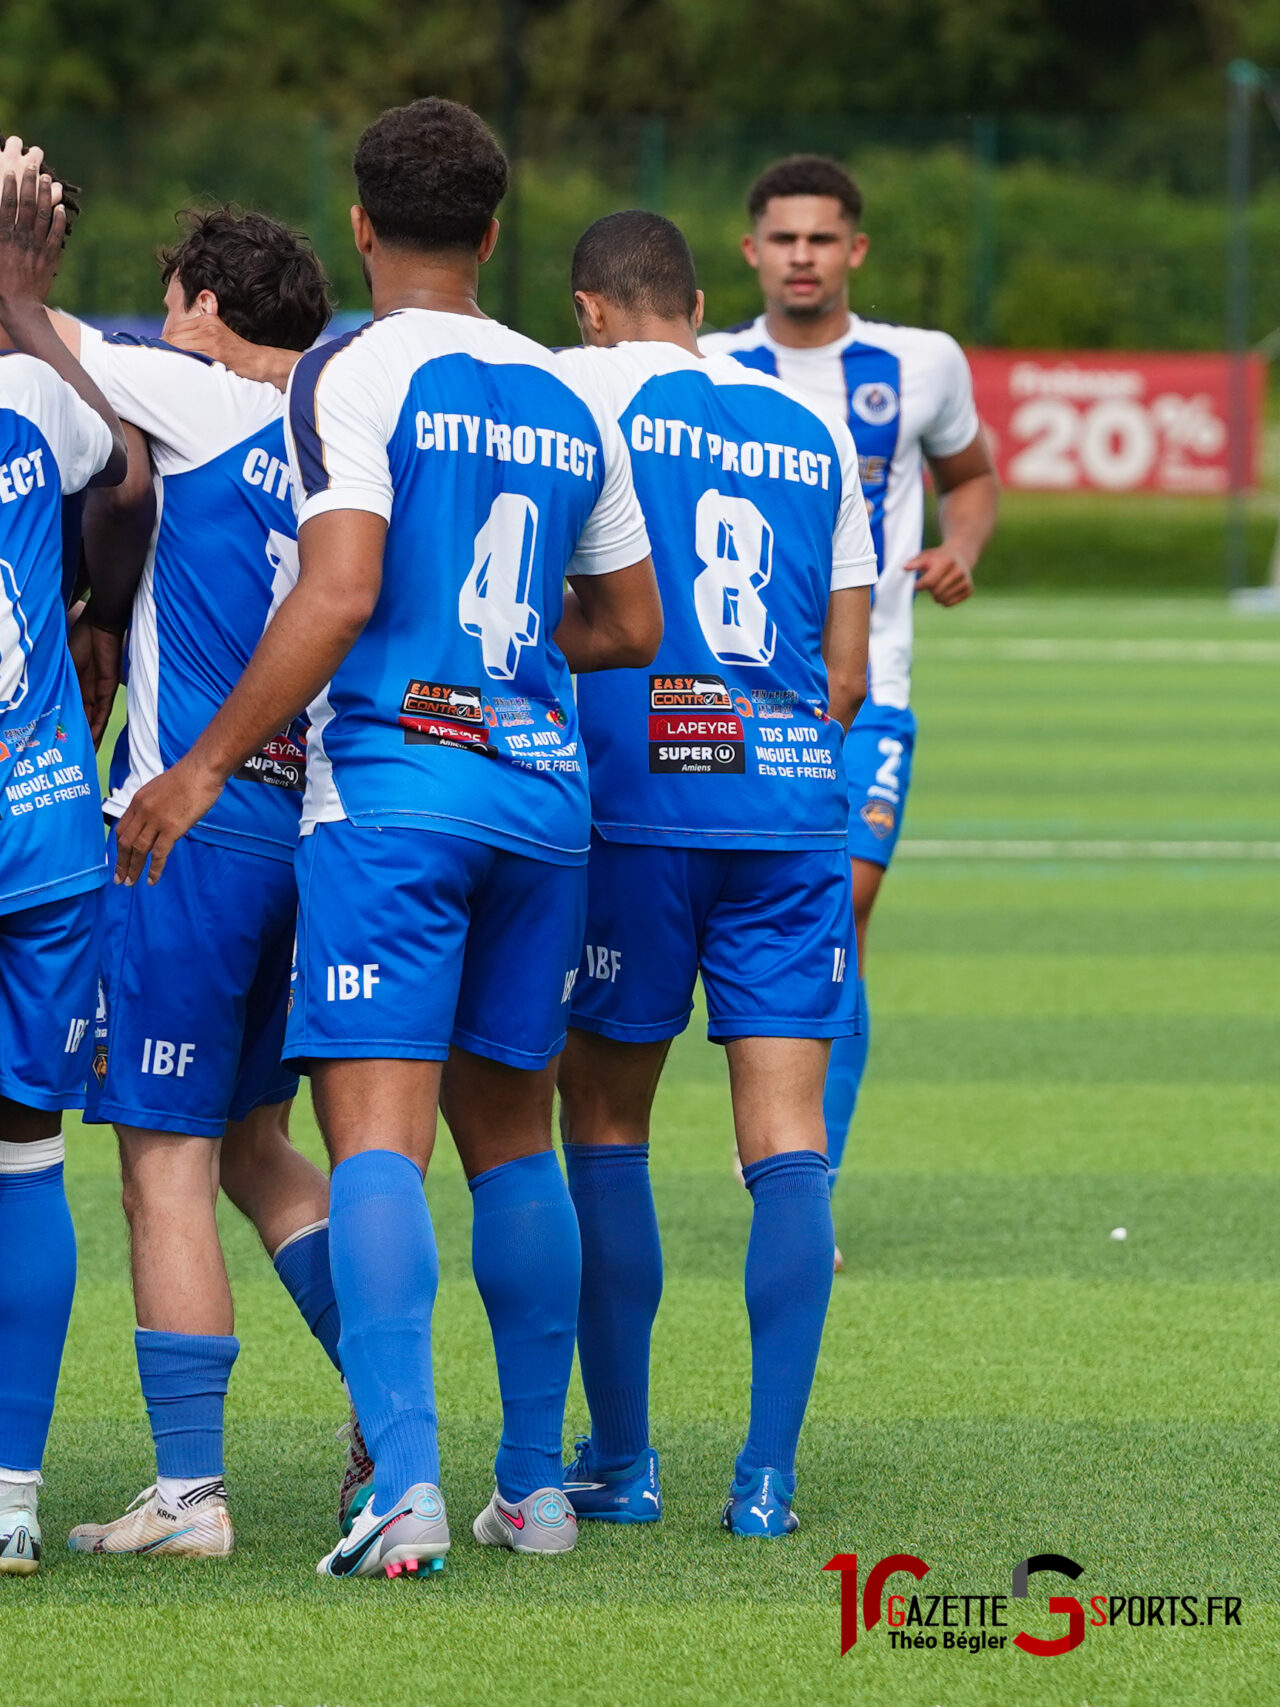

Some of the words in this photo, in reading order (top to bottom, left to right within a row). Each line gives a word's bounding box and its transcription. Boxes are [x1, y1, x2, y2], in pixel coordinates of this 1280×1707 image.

[415, 410, 481, 455] CITY
[485, 418, 598, 482] PROTECT
[631, 414, 701, 460] CITY
[706, 432, 832, 490] PROTECT
[242, 447, 290, 501] CIT
[458, 492, 540, 681] 4
[694, 488, 777, 667] 8
[410, 683, 452, 699] EASY
[654, 678, 694, 690] EASY
[654, 694, 730, 706] CONTROLE
[667, 722, 738, 735] LAPEYRE
[759, 727, 784, 743] TDS
[787, 727, 818, 743] AUTO
[505, 733, 531, 749] TDS
[533, 731, 561, 747] AUTO
[658, 747, 714, 761] SUPER
[755, 746, 799, 763] MIGUEL
[802, 747, 832, 765] ALVES
[536, 760, 551, 771] DE
[681, 763, 711, 772] Amiens
[759, 764, 777, 776] Ets
[780, 766, 795, 778] DE
[797, 766, 837, 780] FREITAS
[4, 774, 53, 802] MIGUEL
[55, 765, 84, 786] ALVES
[11, 803, 34, 816] Ets
[35, 793, 53, 809] DE
[55, 783, 90, 802] FREITAS
[586, 945, 622, 983] IBF
[327, 963, 380, 1002] IBF
[142, 1038, 195, 1079] IBF
